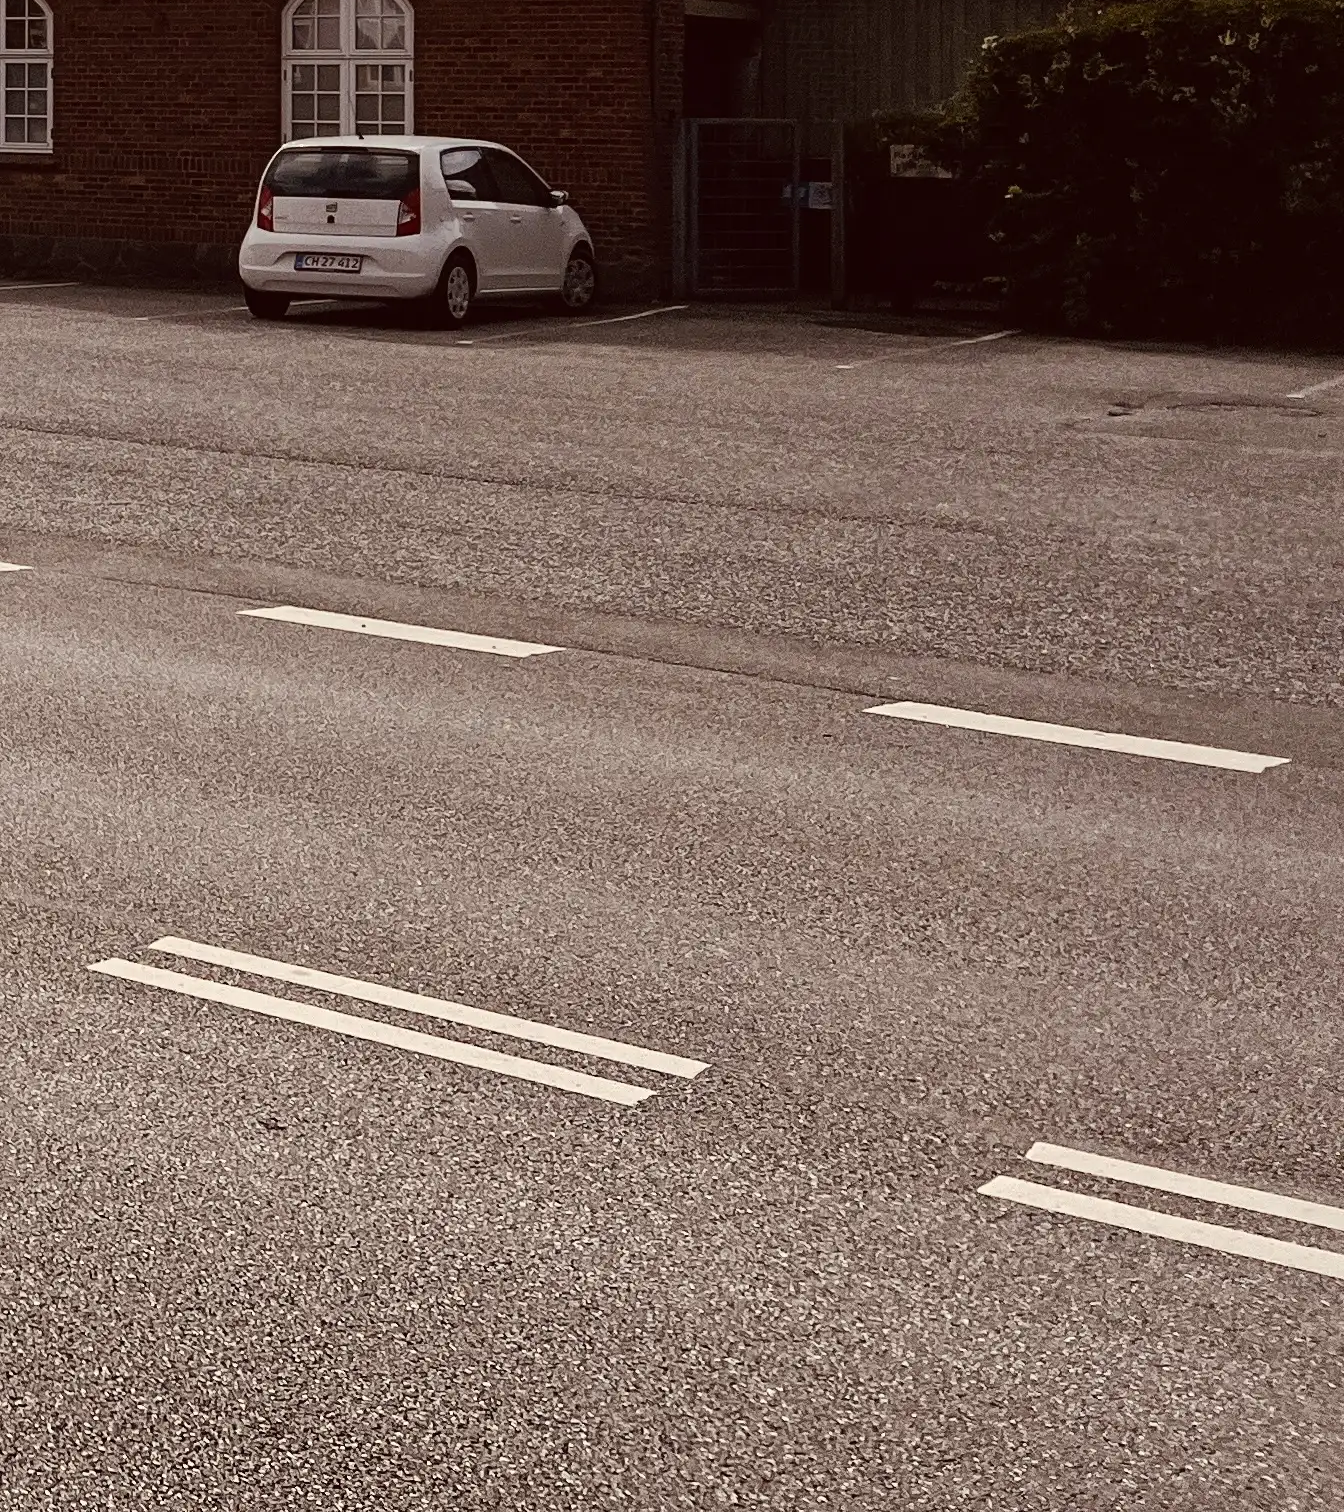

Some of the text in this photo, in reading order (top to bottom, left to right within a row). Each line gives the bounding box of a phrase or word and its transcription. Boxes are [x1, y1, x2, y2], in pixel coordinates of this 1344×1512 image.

[304, 256, 359, 269] CH 27 412
